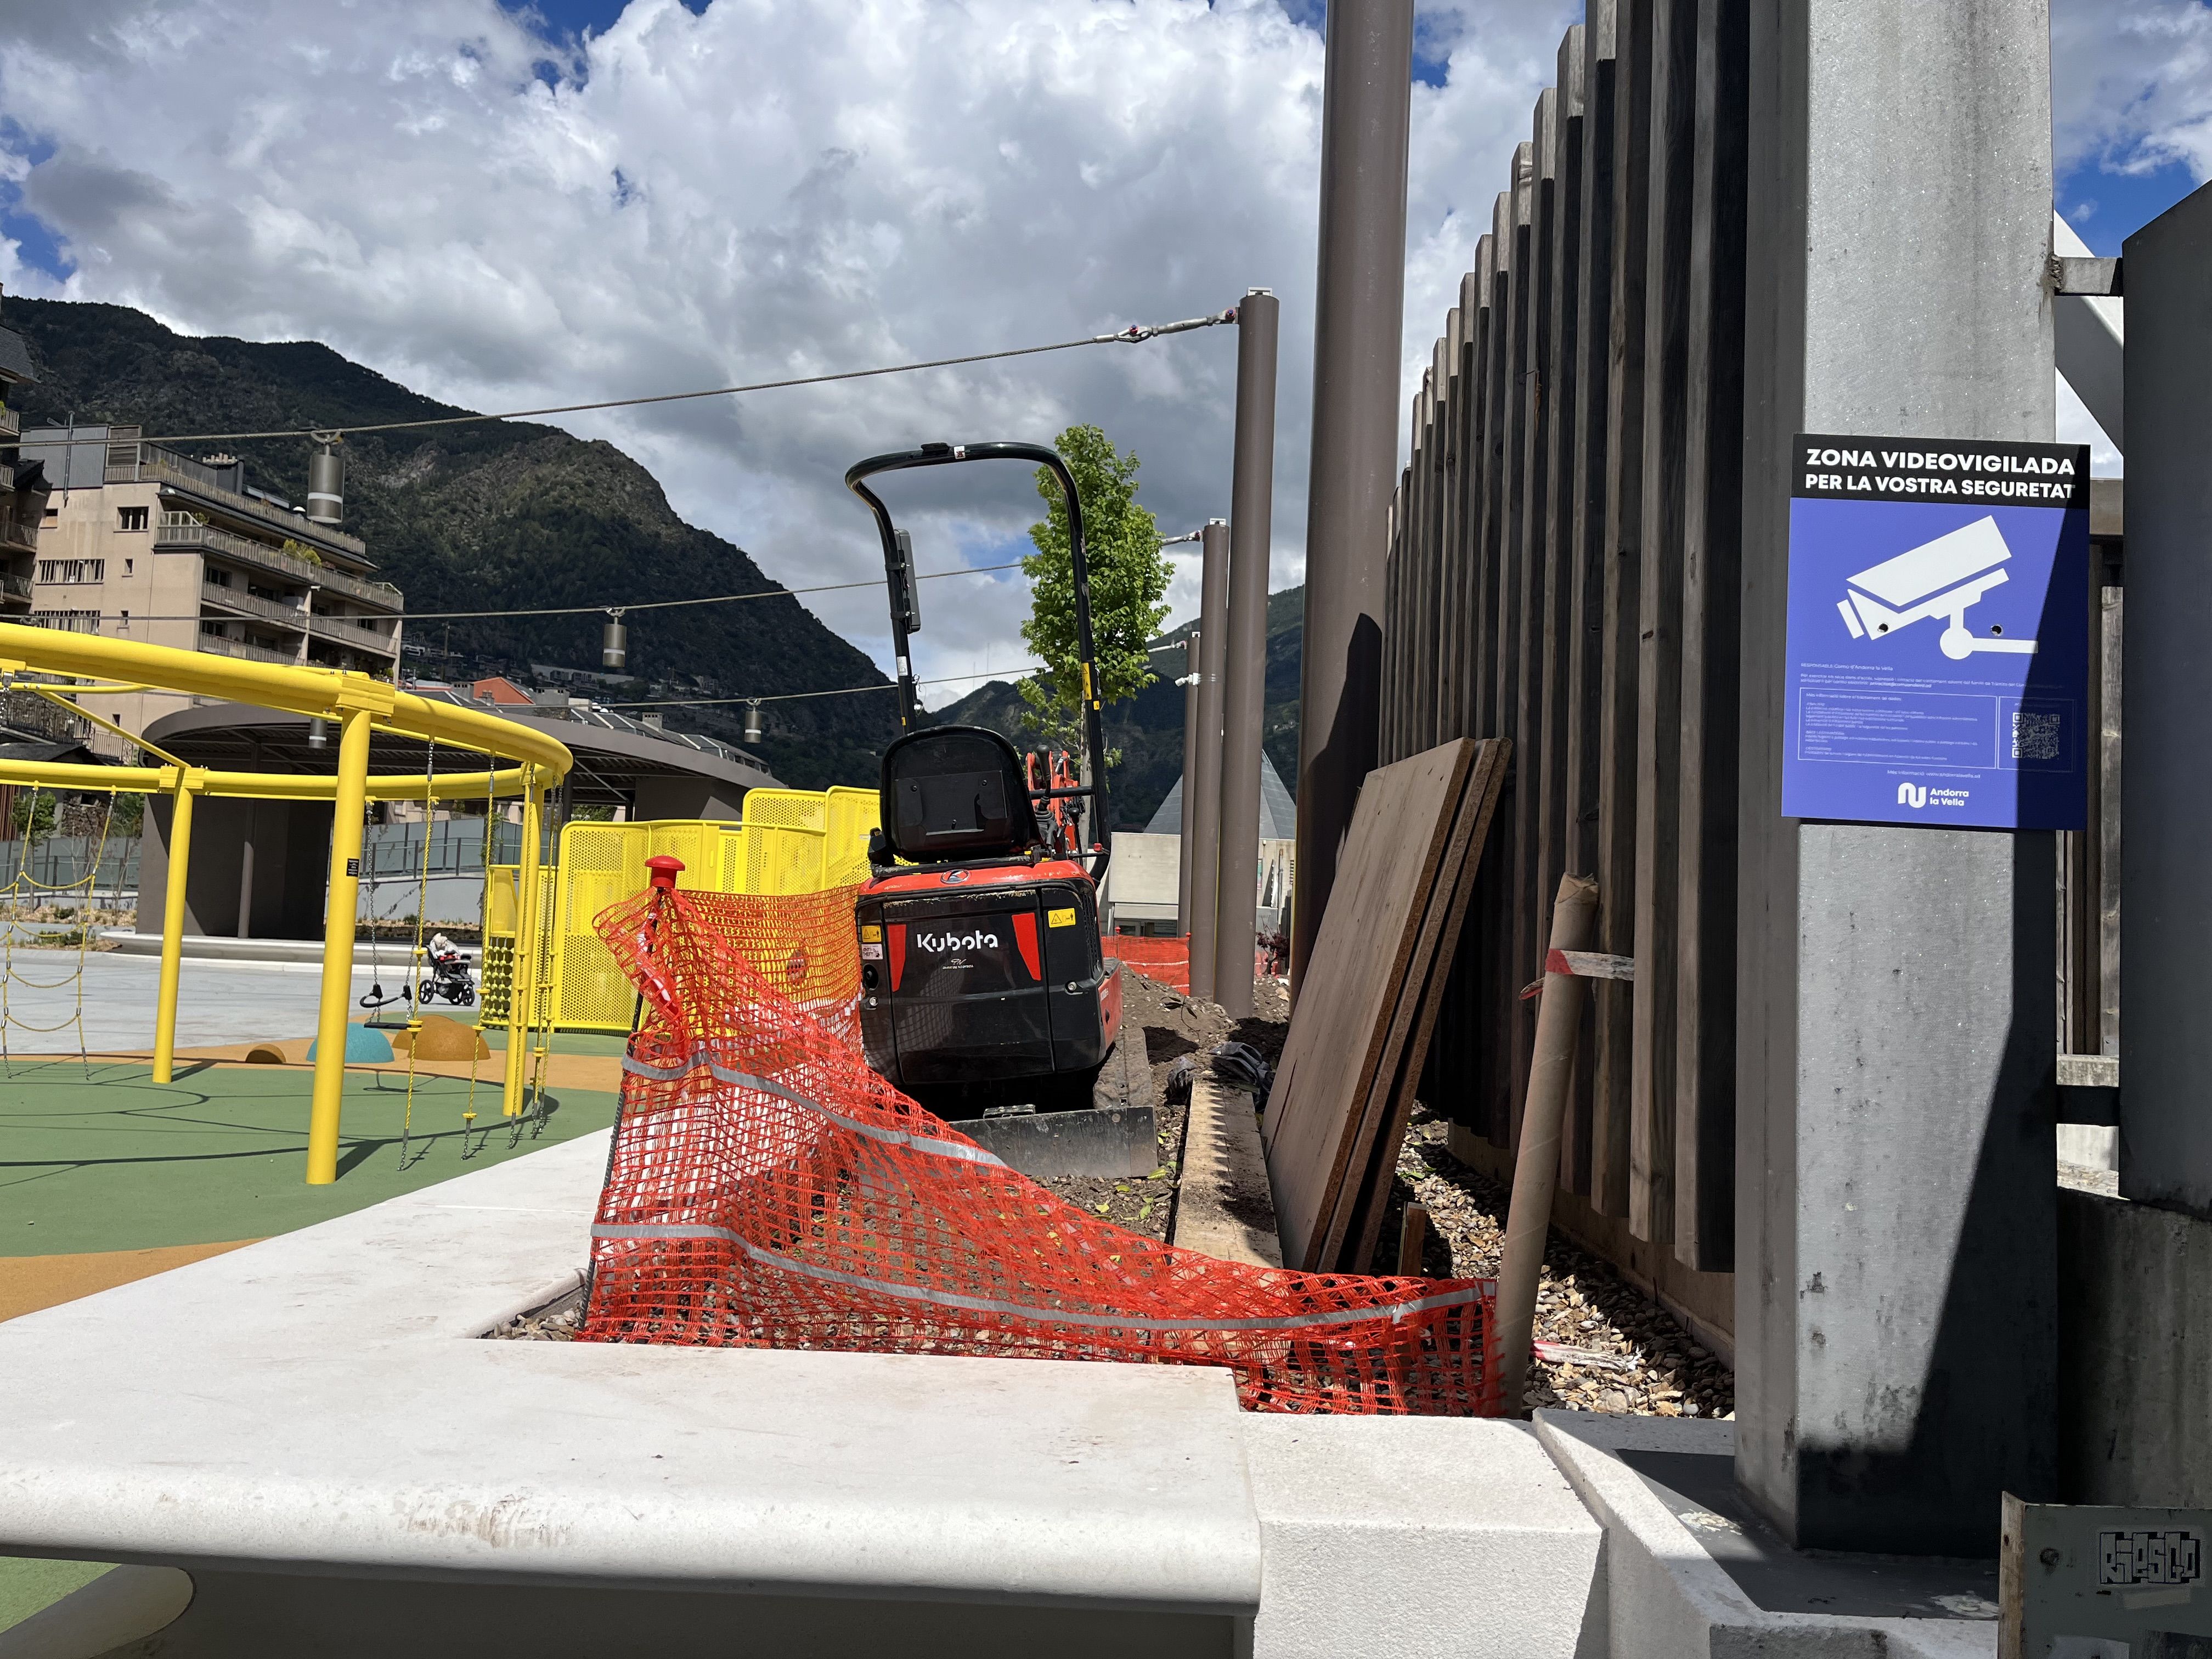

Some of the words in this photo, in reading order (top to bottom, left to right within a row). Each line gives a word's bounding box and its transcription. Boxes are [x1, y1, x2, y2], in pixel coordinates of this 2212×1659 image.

[1806, 448, 1877, 468] ZONA
[1881, 451, 2075, 476] VIDEOVIGILADA
[1805, 475, 1842, 490] PER
[1846, 476, 1872, 490] LA
[1875, 476, 1957, 494] VOSTRA
[1961, 479, 2075, 499] SEGURETAT
[1929, 788, 1970, 797] Andorra
[1940, 798, 1965, 806] Vella
[917, 930, 998, 952] Kubota
